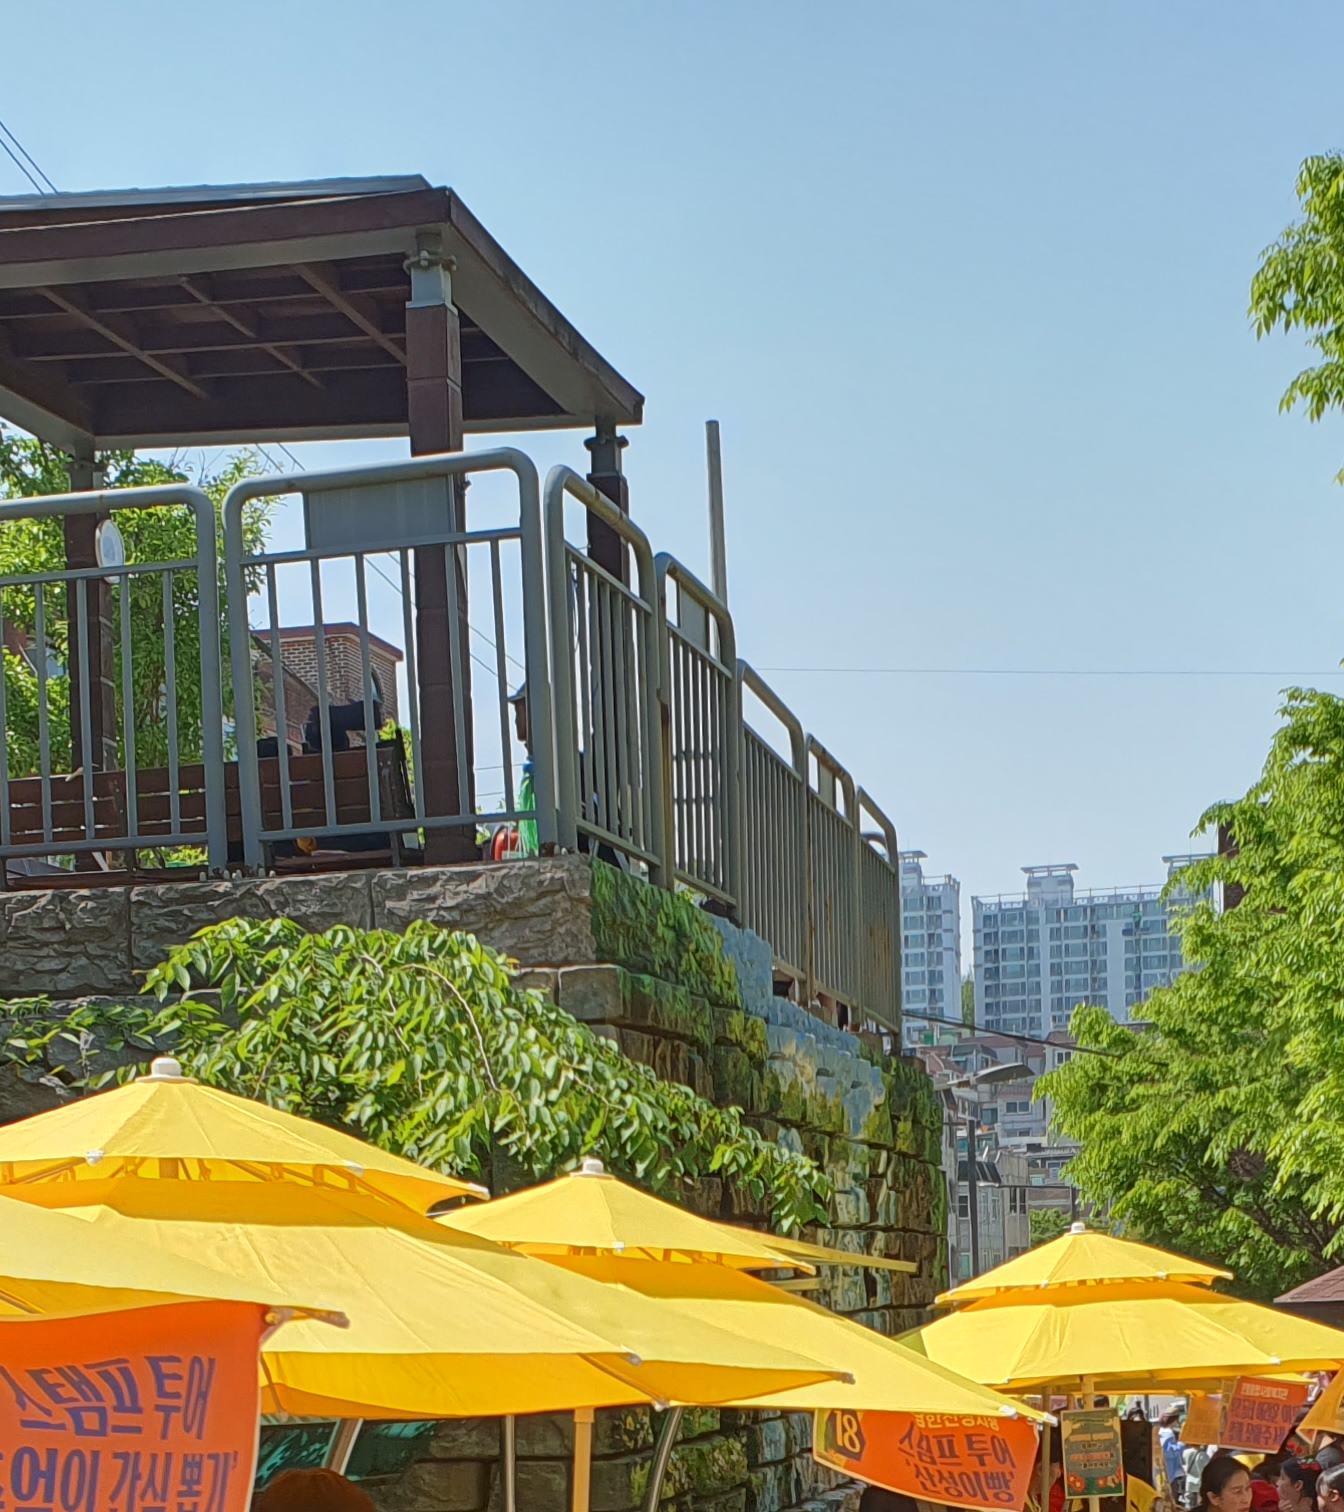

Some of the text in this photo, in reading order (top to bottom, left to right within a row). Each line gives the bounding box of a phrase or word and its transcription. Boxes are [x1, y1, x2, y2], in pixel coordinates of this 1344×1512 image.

[144, 1355, 216, 1440] 투어
[834, 1410, 861, 1454] 18
[964, 1433, 1016, 1469] 투어
